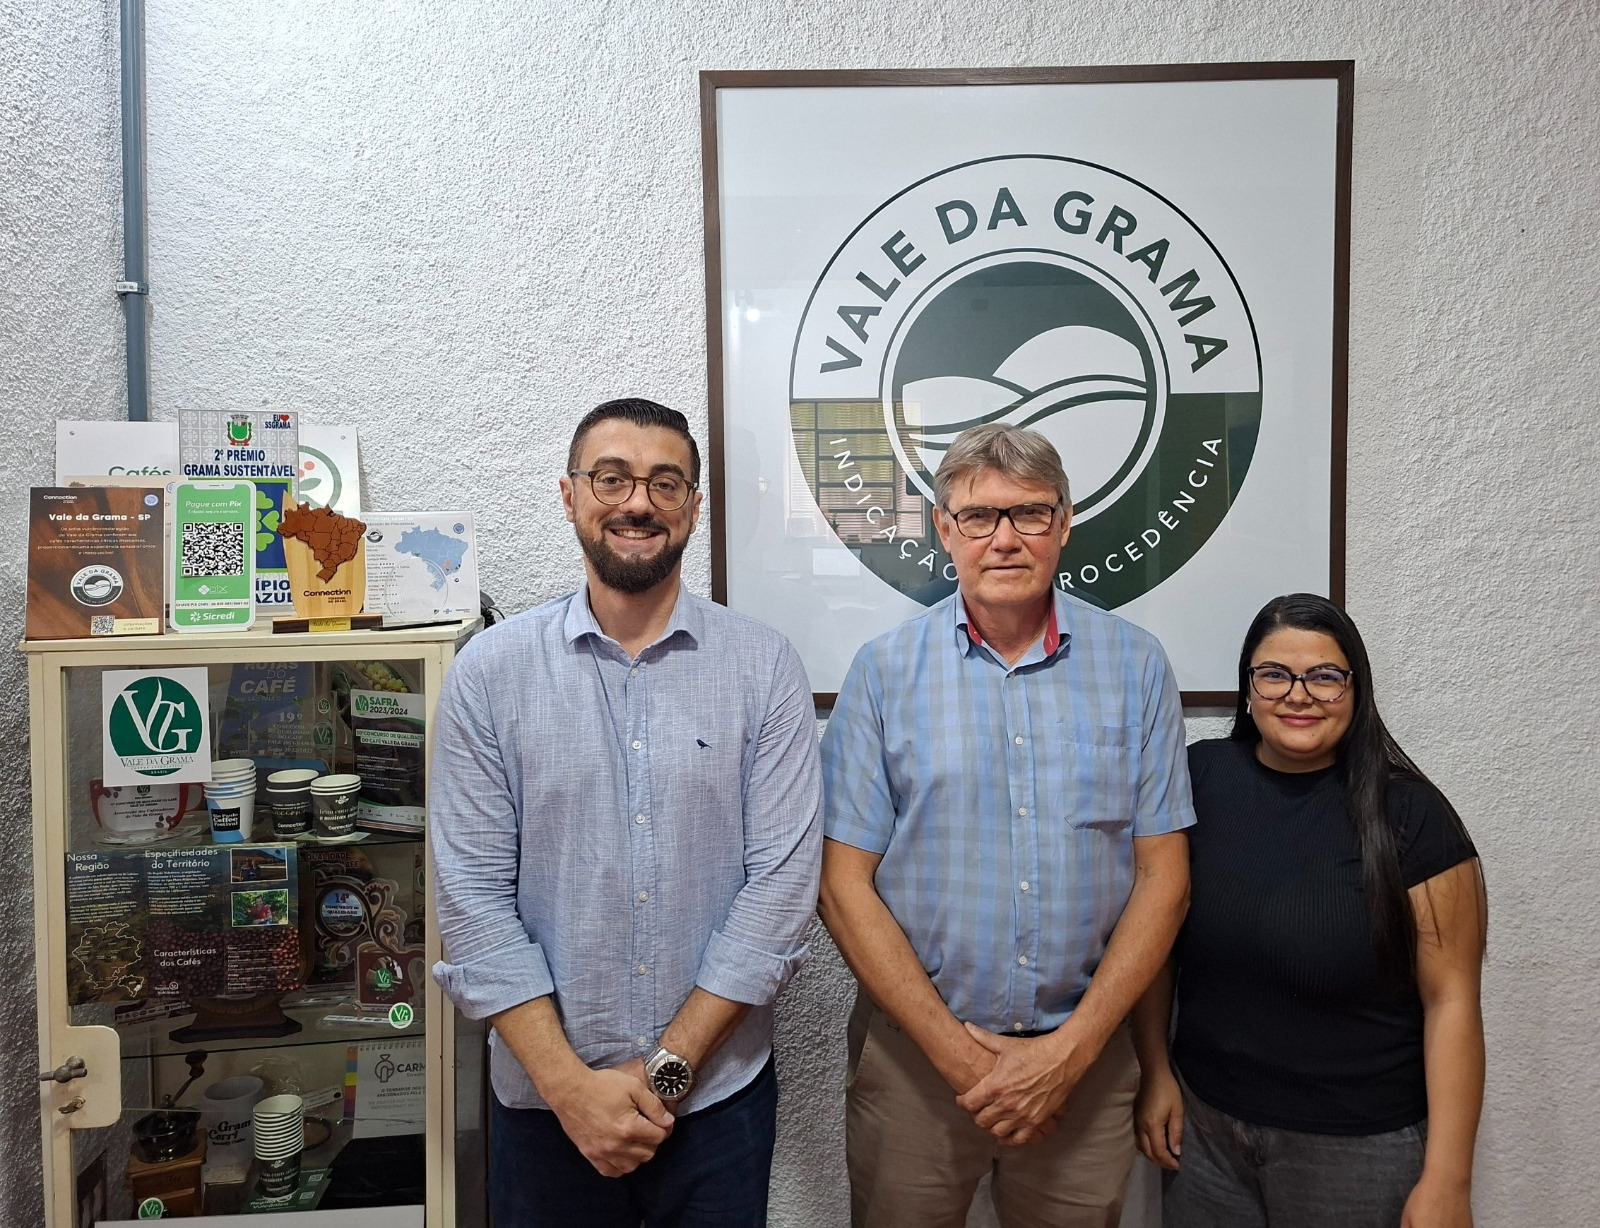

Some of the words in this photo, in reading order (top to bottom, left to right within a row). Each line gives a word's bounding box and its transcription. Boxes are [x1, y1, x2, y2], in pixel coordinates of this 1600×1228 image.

[820, 229, 928, 374] VALE
[934, 187, 1028, 245] DA
[1053, 190, 1229, 374] GRAMA
[264, 421, 291, 429] SSGRAMA
[214, 449, 224, 461] 2º
[227, 447, 266, 462] PRÊMIO
[184, 464, 221, 477] GRAMA
[223, 462, 296, 477] SUSTENTÁVEL
[49, 513, 73, 521] Vale
[75, 513, 89, 521] da
[92, 513, 128, 521] Grama
[138, 513, 151, 521] SP
[829, 437, 958, 581] INDICAÇÃO
[1058, 437, 1224, 592] ROCEDÊNCIA
[76, 572, 88, 585] VALE
[101, 569, 119, 585] GRAMA
[303, 589, 351, 597] Connection
[203, 612, 235, 621] Sicredi
[267, 669, 286, 679] DO
[240, 676, 296, 694] CAFÉ
[369, 697, 399, 706] SAFRA
[120, 678, 193, 753] VG
[369, 706, 408, 716] 2023/2024
[120, 758, 144, 767] VALE
[160, 756, 194, 766] GRAMA
[67, 854, 98, 862] Nossa
[145, 848, 218, 860] Especificidades
[76, 862, 110, 873] Região
[151, 860, 164, 869] do
[166, 859, 210, 868] Território
[153, 948, 217, 957] Características
[177, 958, 201, 966] Cafés
[393, 1006, 410, 1021] VG
[144, 1200, 159, 1216] VG
